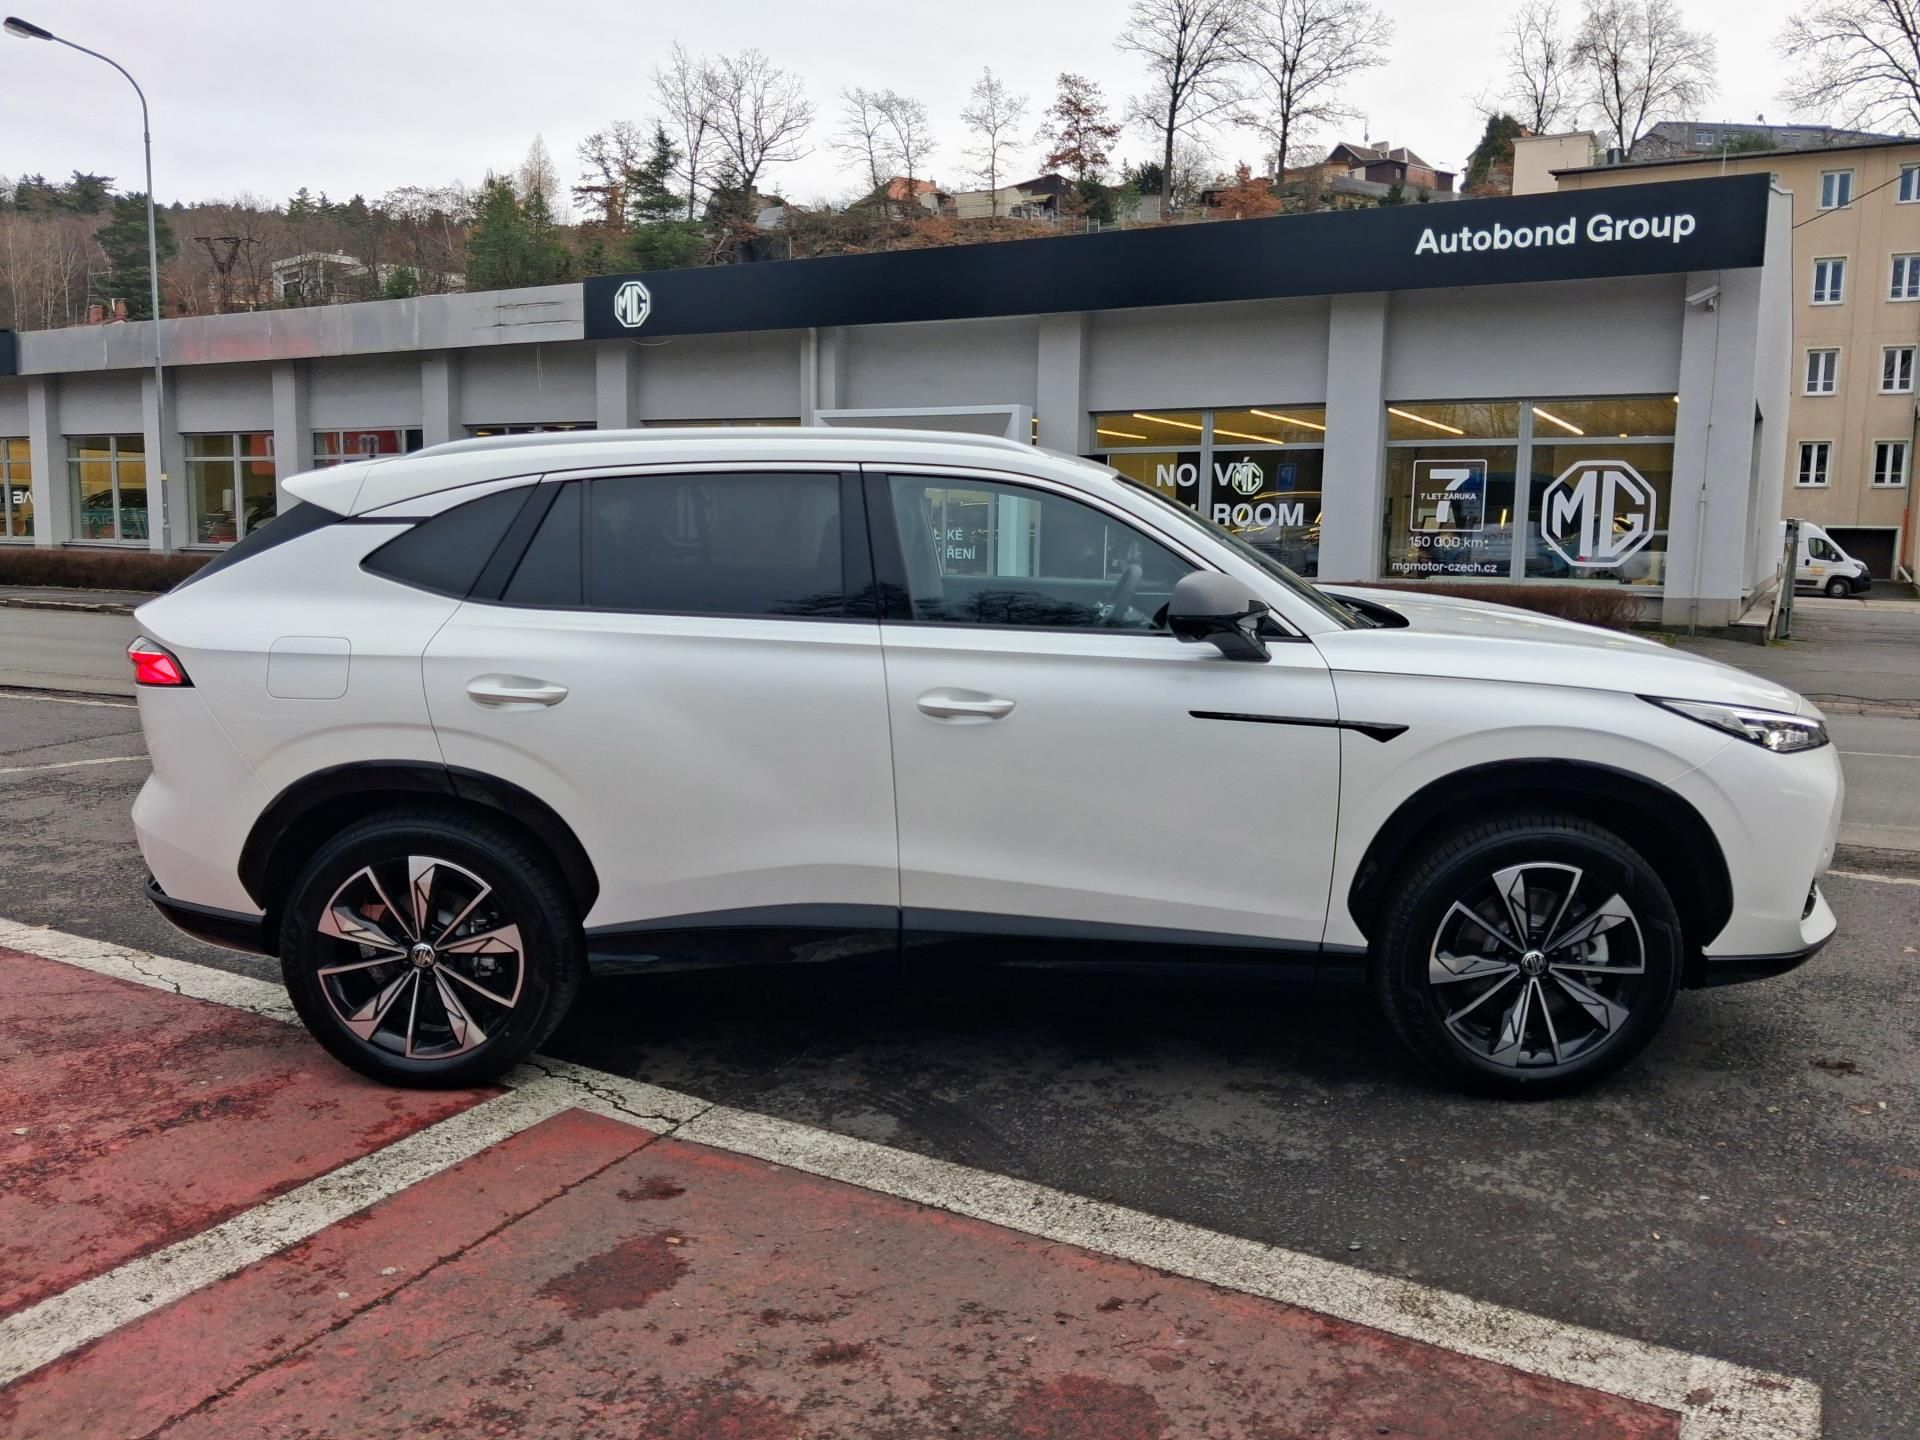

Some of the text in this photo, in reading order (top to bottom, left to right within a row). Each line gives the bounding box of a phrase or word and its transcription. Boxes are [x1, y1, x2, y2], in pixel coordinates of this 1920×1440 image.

[1415, 213, 1696, 255] Autobond Group
[616, 284, 649, 325] MG
[1234, 464, 1261, 493] MG
[1443, 491, 1477, 500] ZÁRUKA
[1549, 468, 1648, 559] MG
[1409, 536, 1430, 549] 150
[1433, 536, 1461, 549] 000
[1392, 562, 1498, 575] mgmotor-czech.cz
